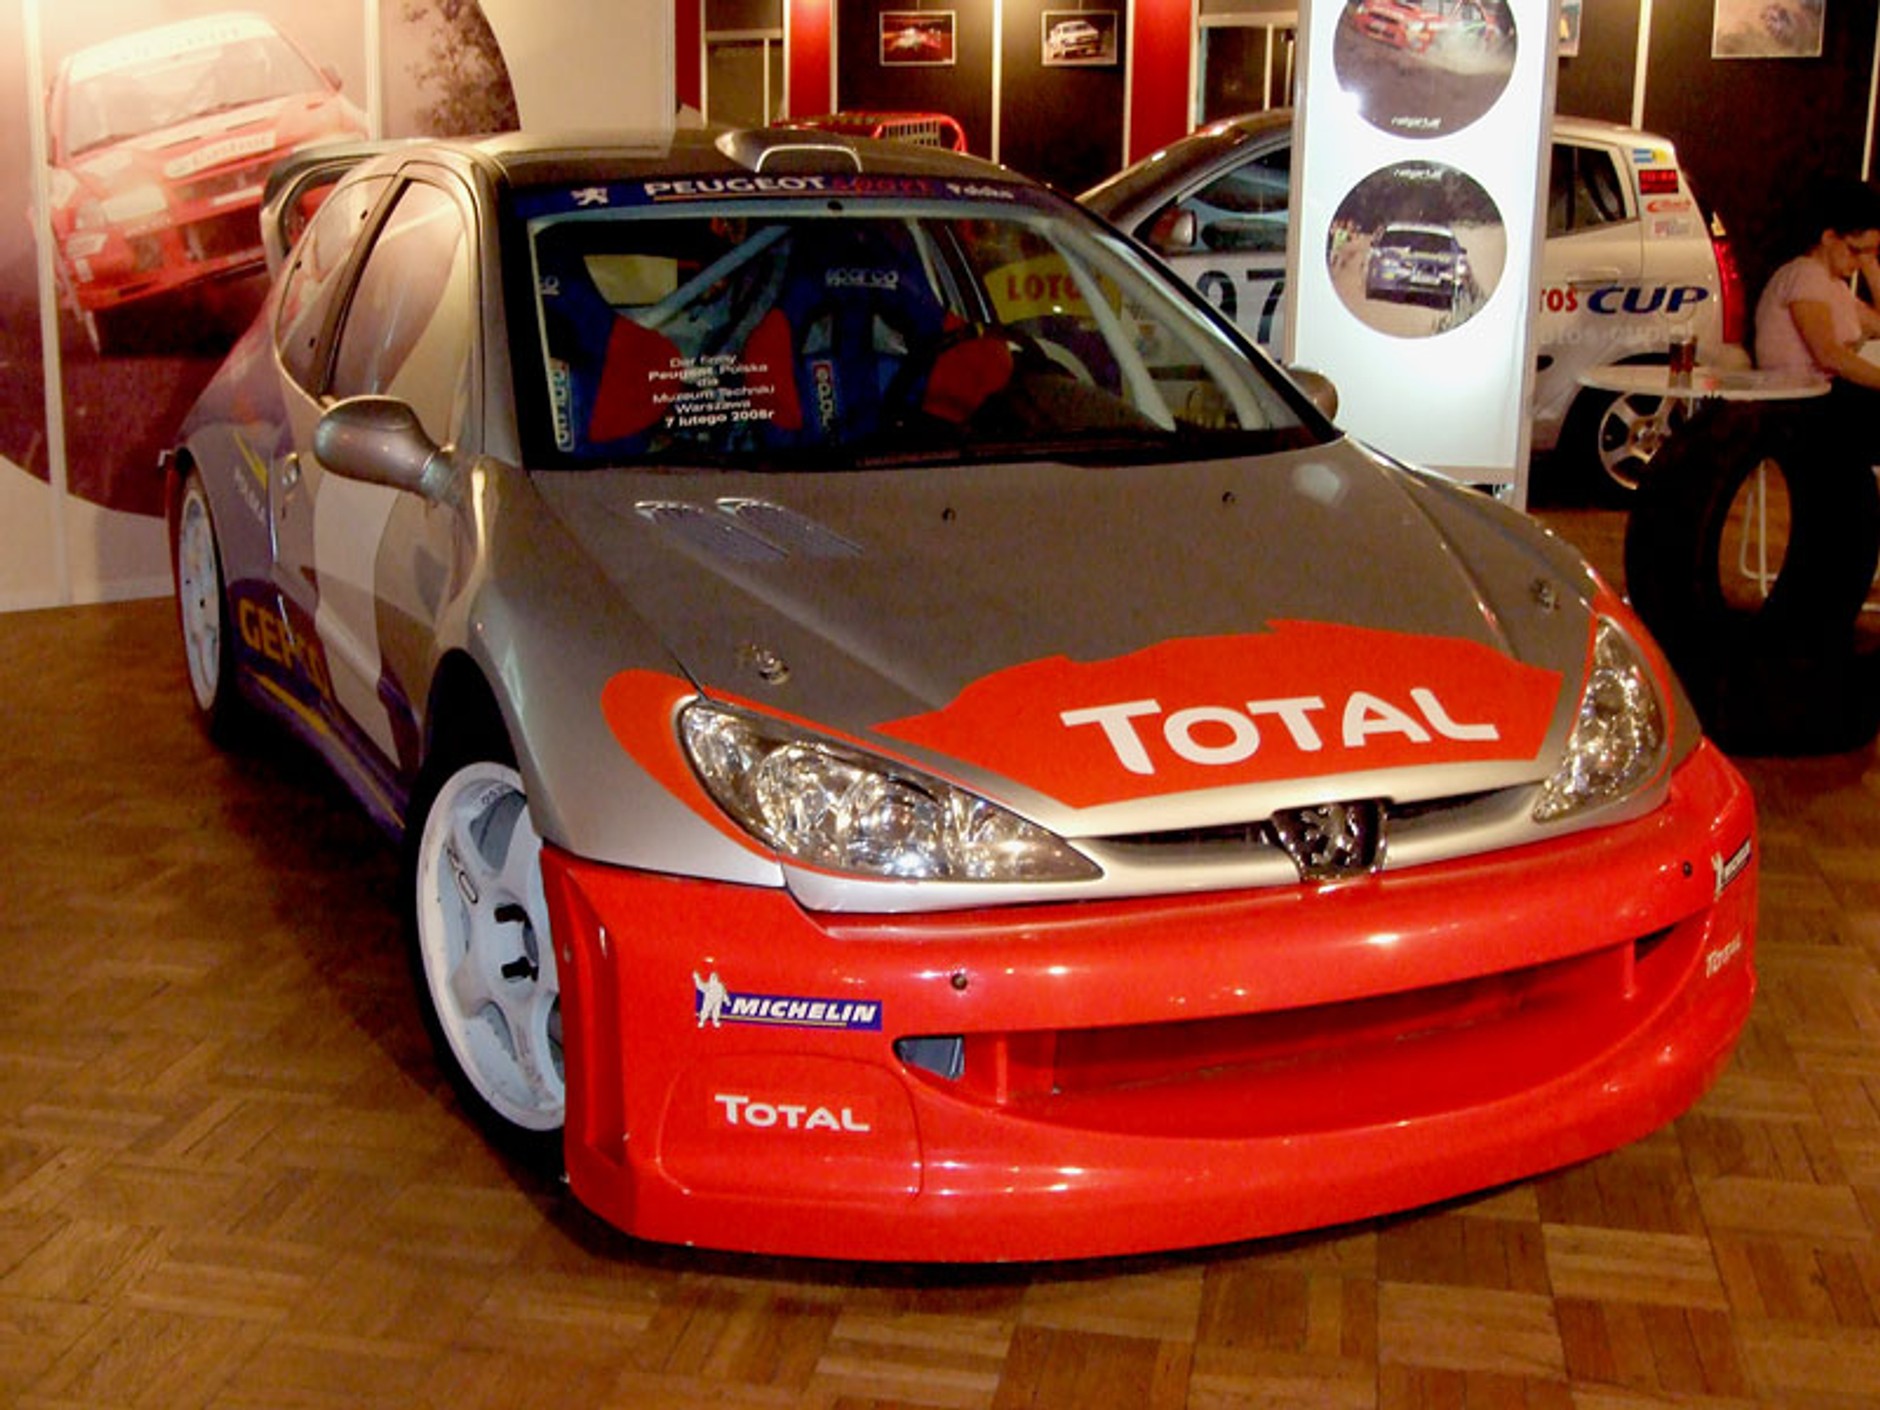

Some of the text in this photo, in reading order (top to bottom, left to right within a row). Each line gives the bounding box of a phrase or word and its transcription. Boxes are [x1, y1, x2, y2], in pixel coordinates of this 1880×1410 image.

[644, 176, 826, 196] PEUGEOT
[1586, 284, 1709, 314] CUP
[665, 415, 675, 429] 7
[678, 413, 727, 426] lutego
[1060, 687, 1499, 775] TOTAL
[731, 998, 877, 1022] MICHELIN
[714, 1094, 871, 1132] TOTAL
